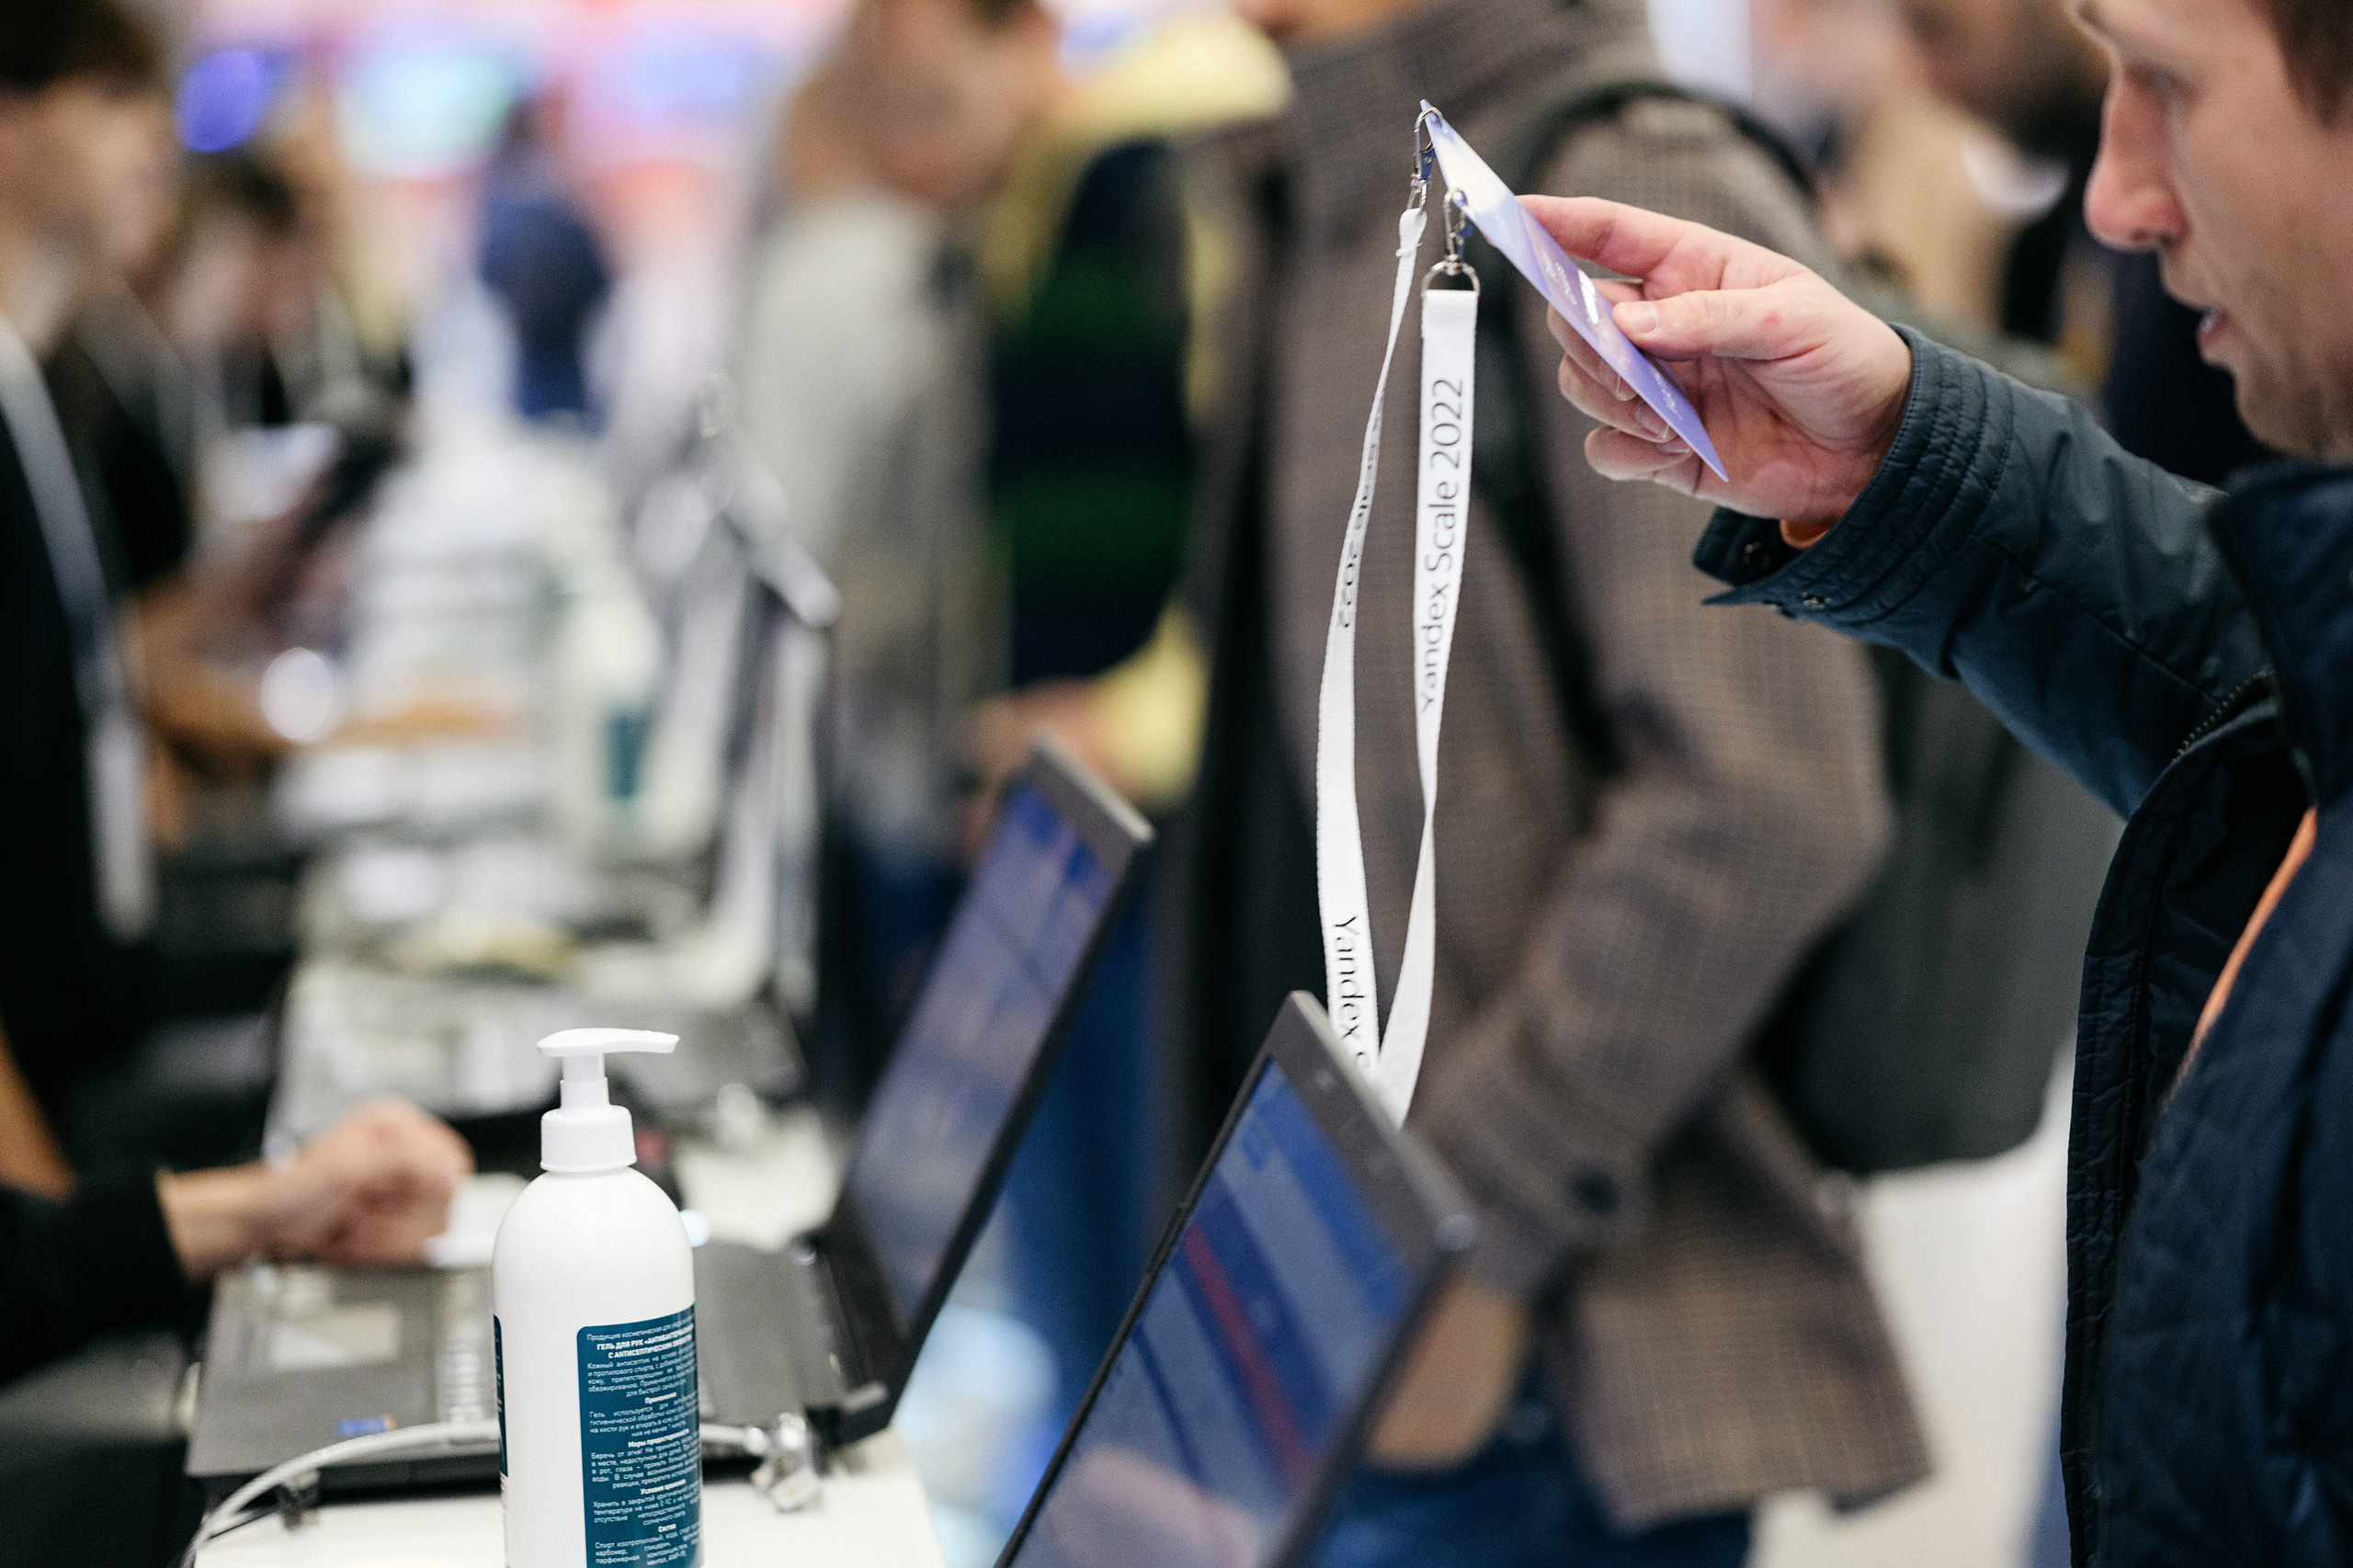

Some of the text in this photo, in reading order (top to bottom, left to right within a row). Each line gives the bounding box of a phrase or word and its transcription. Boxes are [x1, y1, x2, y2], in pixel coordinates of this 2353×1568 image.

[1421, 380, 1462, 712] Yandex Scale 2022
[1335, 915, 1364, 1038] Yandex
[615, 1341, 631, 1349] ДЛЯ
[616, 1358, 651, 1367] антисептик
[593, 1368, 633, 1378] пропилового
[638, 1385, 661, 1394] быстрой
[613, 1407, 653, 1416] используется
[590, 1415, 636, 1425] гигиенической
[638, 1411, 665, 1421] обработки
[627, 1448, 643, 1456] огня!
[620, 1454, 657, 1463] недоступном
[623, 1471, 644, 1480] случае
[612, 1481, 641, 1489] реакции,
[628, 1494, 655, 1506] закрытой
[593, 1507, 633, 1516] температуре
[594, 1515, 628, 1524] отсутствие
[595, 1541, 615, 1550] Спирт
[616, 1533, 665, 1548] изопропиловый,
[595, 1548, 629, 1556] карбомер,
[595, 1554, 641, 1564] парфюмерная
